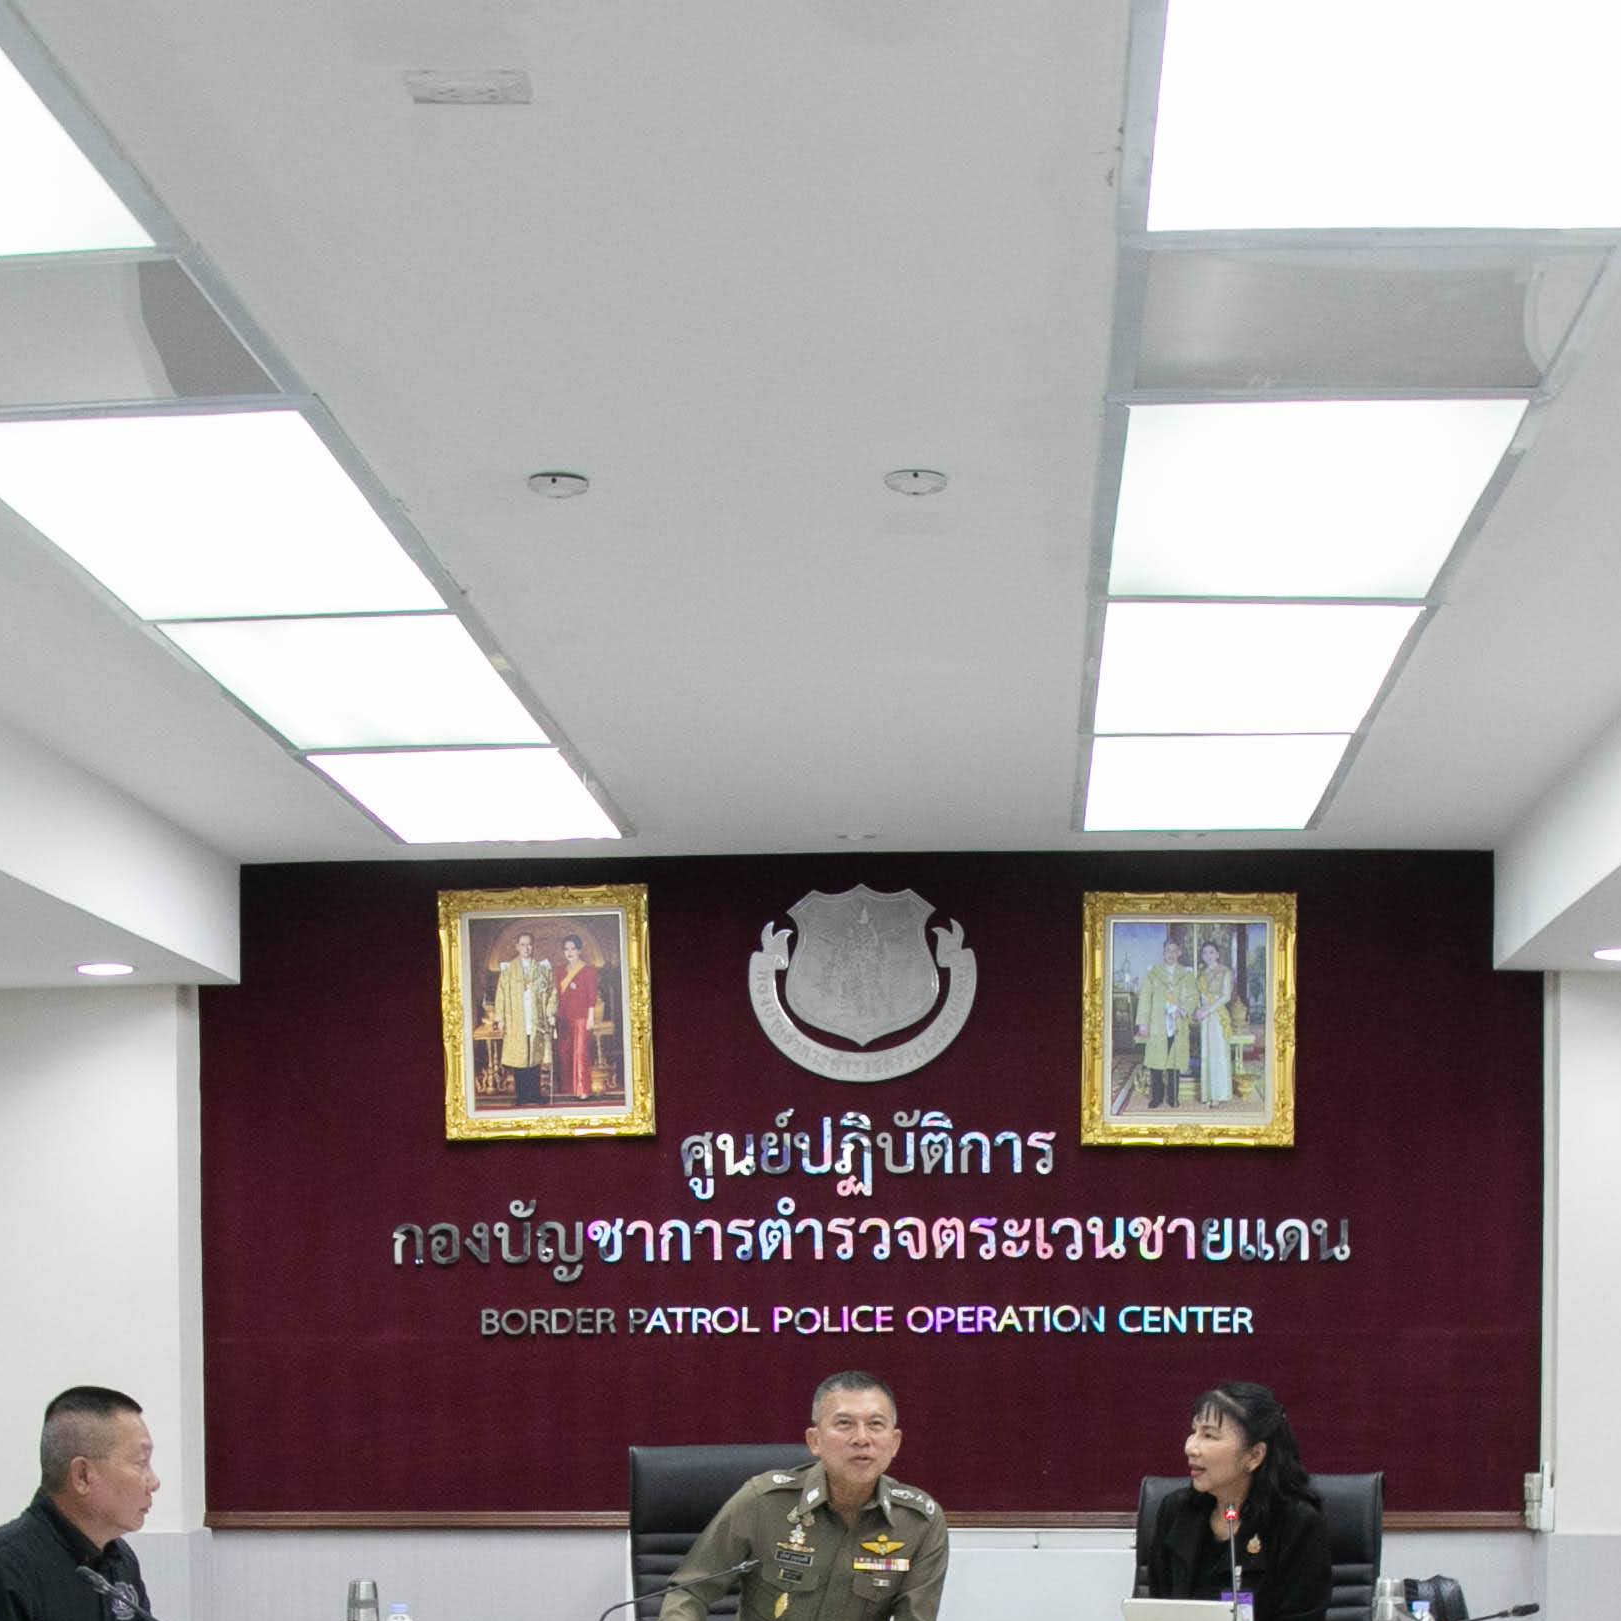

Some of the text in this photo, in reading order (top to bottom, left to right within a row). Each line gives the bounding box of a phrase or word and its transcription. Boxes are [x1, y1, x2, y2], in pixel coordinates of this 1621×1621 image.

[679, 1107, 1057, 1199] ศูนย์ปฏิบัติการ
[391, 1198, 1352, 1282] กองบัญชาการตำรวจตระเวนชายแดน
[480, 1303, 1254, 1335] BORDER PATROL POLICE OPERATION CENTER
